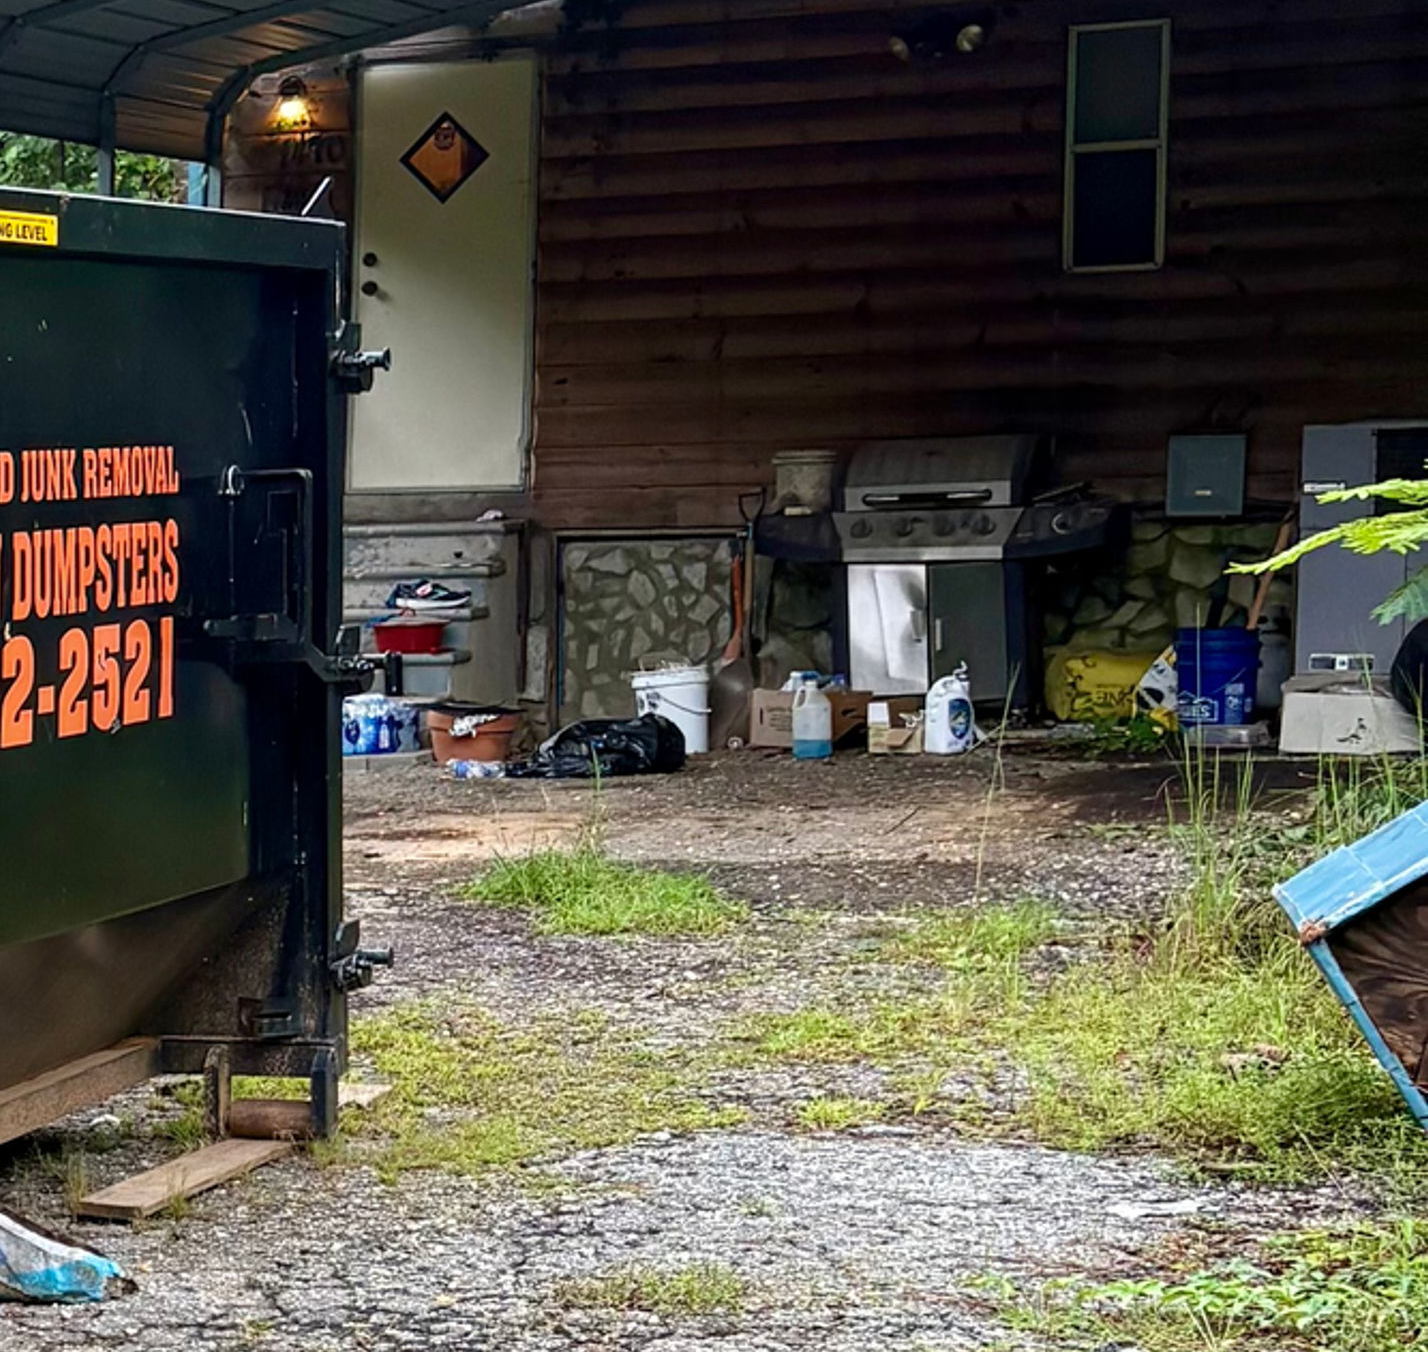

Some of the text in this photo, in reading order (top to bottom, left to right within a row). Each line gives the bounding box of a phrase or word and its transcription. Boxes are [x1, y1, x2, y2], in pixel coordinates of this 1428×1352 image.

[15, 223, 48, 242] LEVEL
[21, 449, 77, 503] JUNK
[83, 446, 180, 499] REMOVAL
[11, 519, 180, 621] DUMPSTERS
